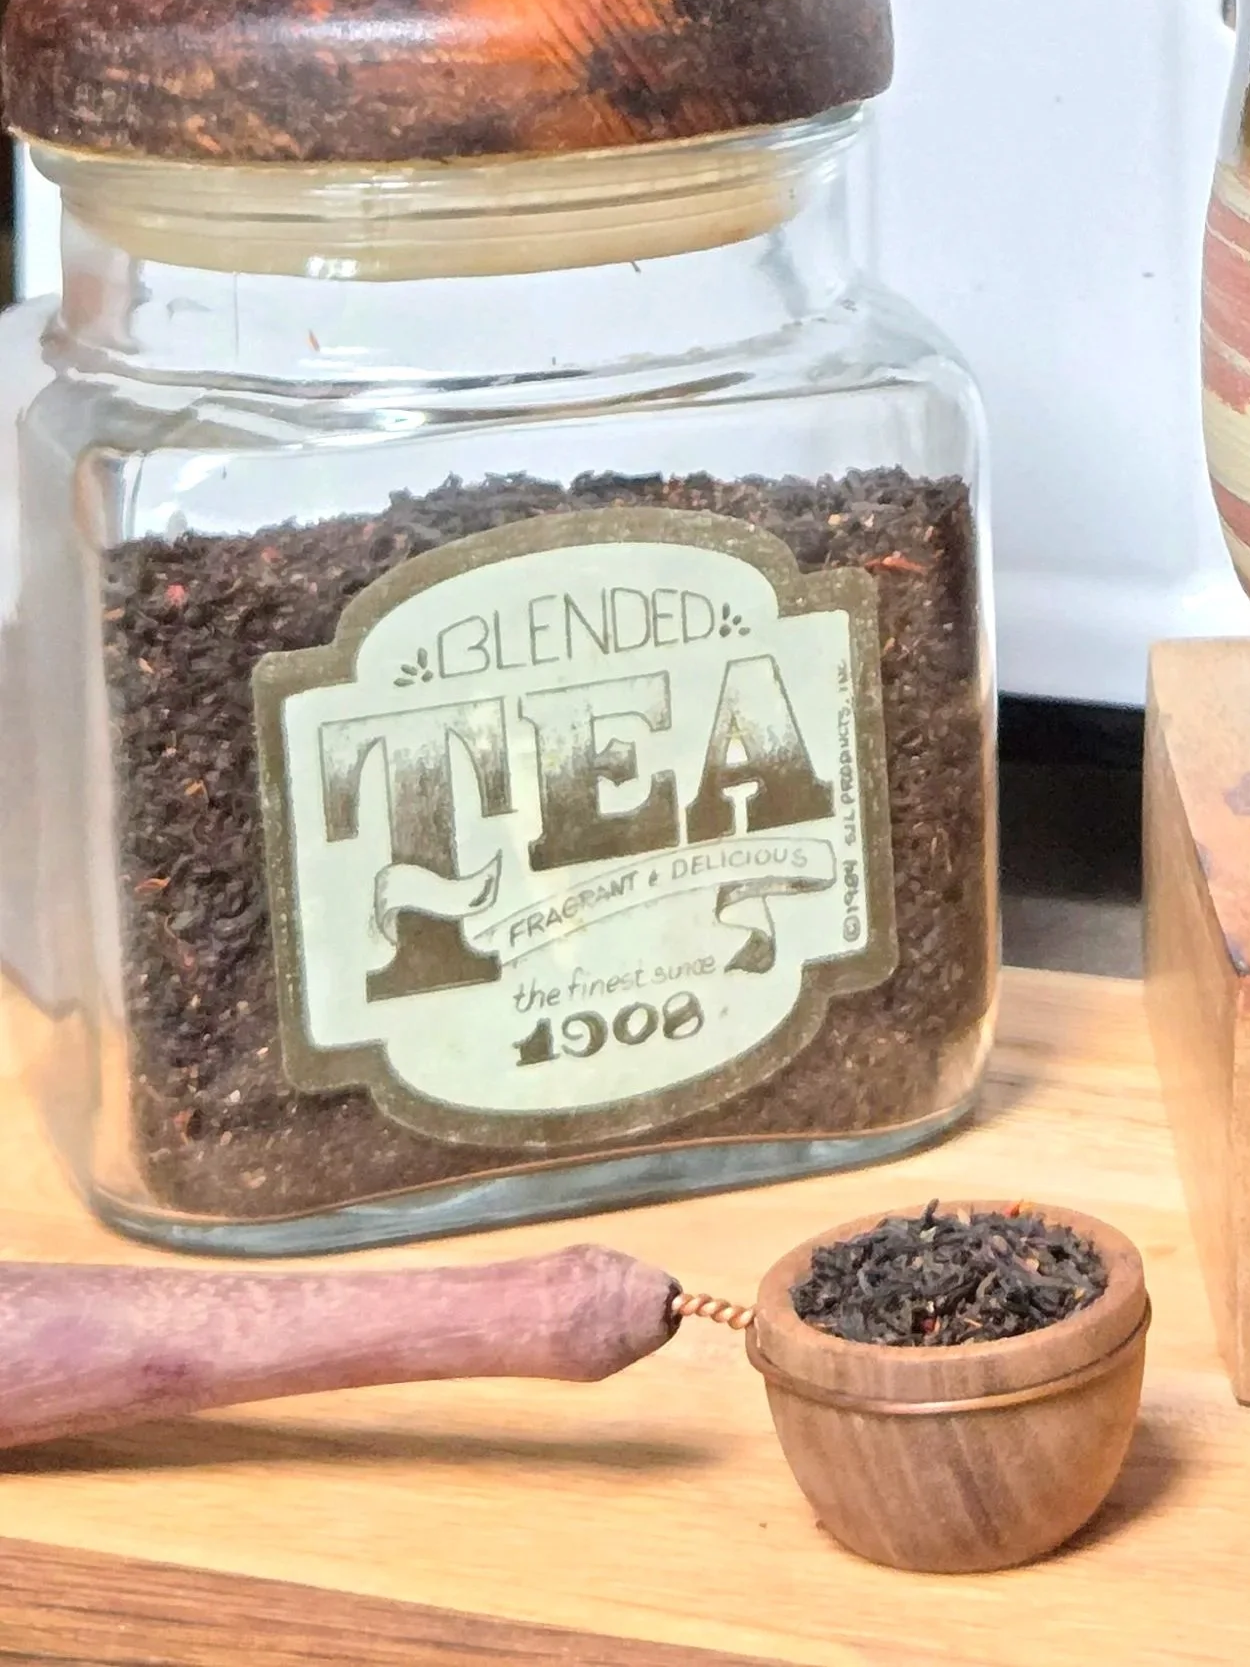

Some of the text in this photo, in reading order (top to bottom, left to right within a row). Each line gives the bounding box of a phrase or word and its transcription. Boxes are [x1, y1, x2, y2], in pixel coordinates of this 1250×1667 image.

[437, 588, 714, 679] BLENDED
[318, 654, 835, 1003] TEA
[508, 870, 639, 947] FRAGRANT
[671, 847, 808, 881] DELICIOUS
[512, 979, 562, 1013] the
[568, 959, 642, 1001] finest
[512, 991, 705, 1067] 1908
